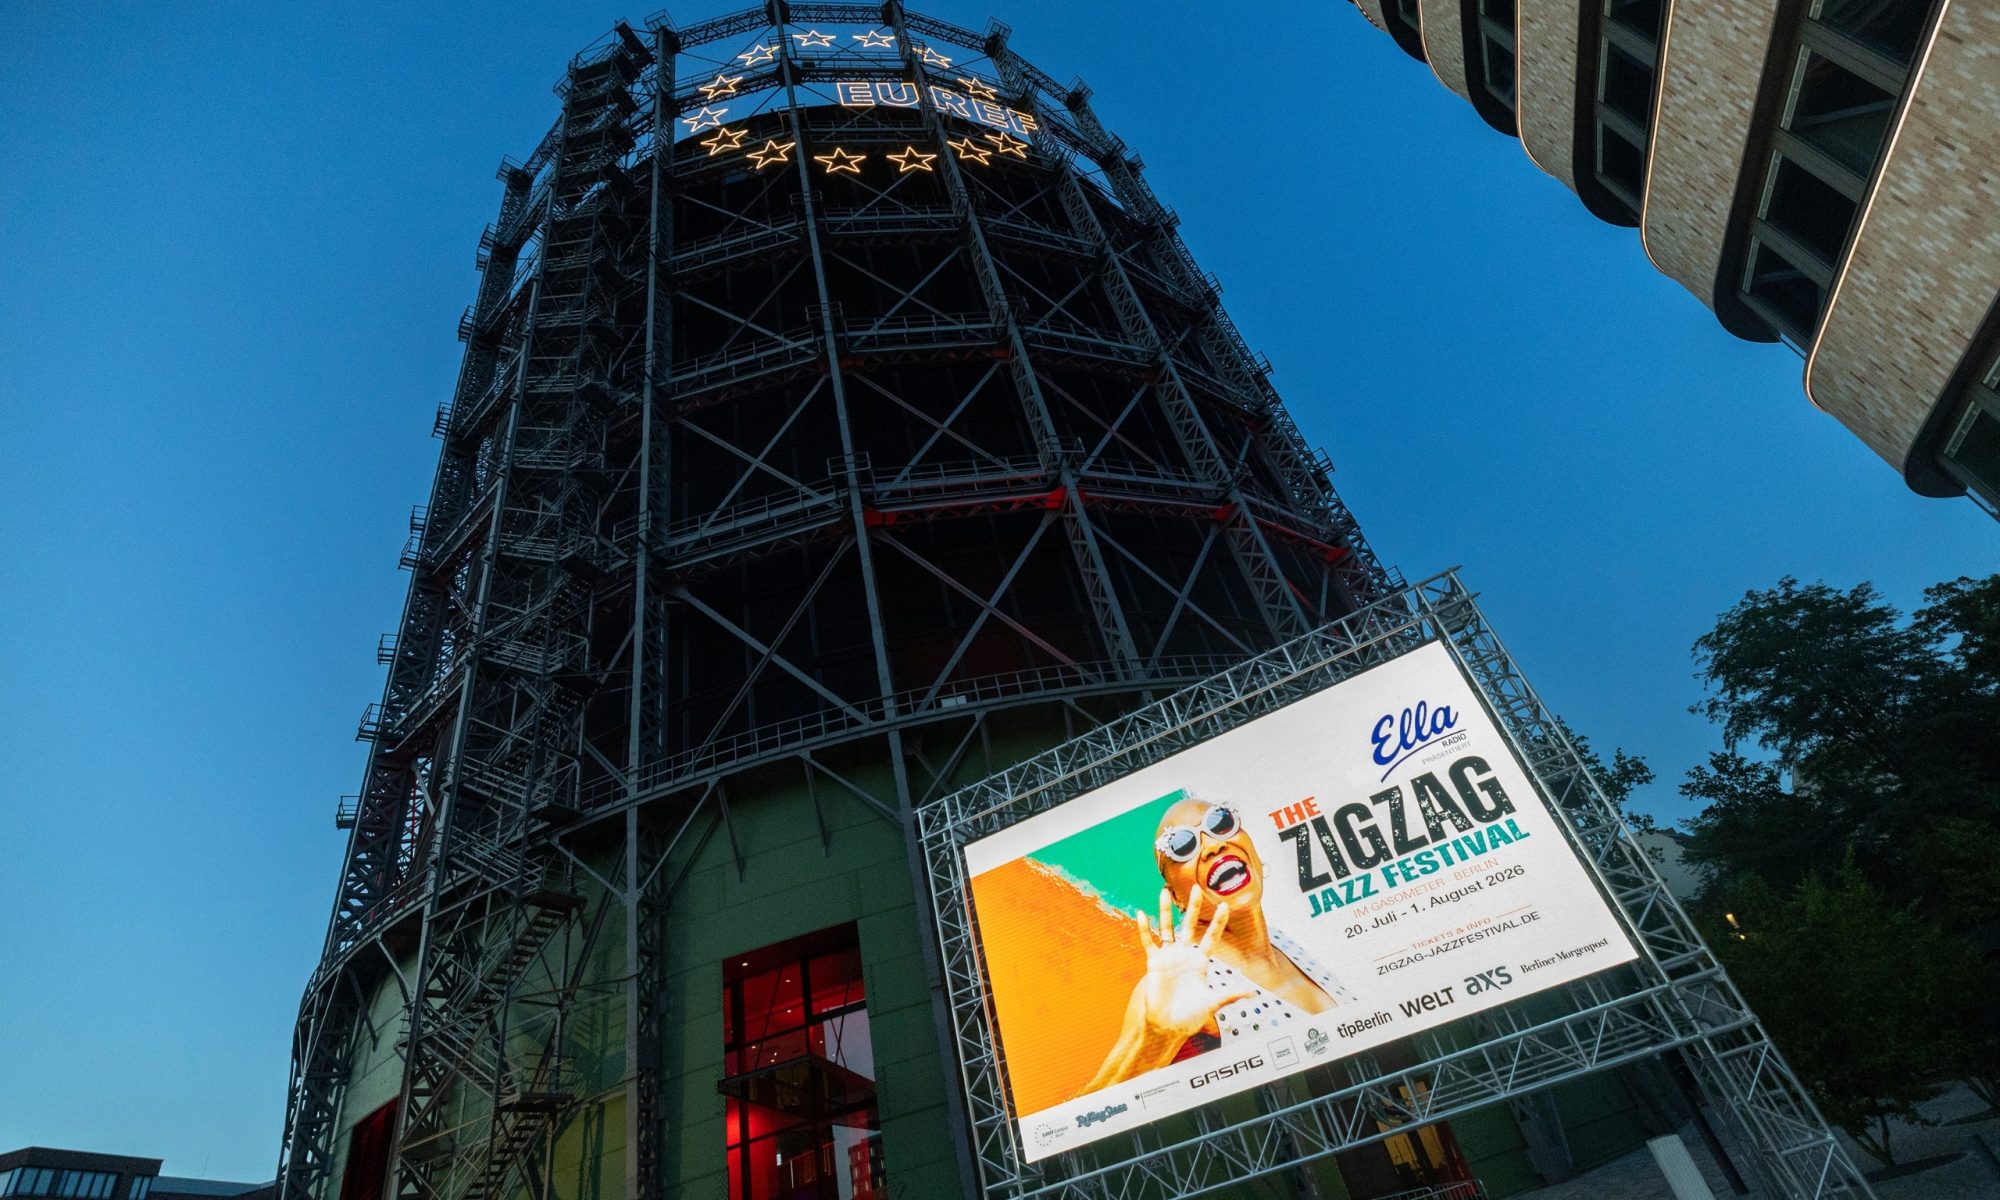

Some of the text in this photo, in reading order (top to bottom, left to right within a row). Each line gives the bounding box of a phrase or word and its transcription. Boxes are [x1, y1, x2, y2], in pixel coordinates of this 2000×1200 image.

[1371, 700, 1459, 766] Ella
[1441, 733, 1467, 748] RADIO
[1268, 796, 1320, 830] THE
[1279, 755, 1517, 894] ZIGZAG
[1307, 818, 1531, 919] JAZZ FESTIVAL
[1353, 857, 1500, 918] IM GASOMETER BERLIN
[1344, 923, 1368, 939] 20.
[1372, 910, 1397, 929] Juli
[1410, 903, 1426, 914] 1.
[1429, 880, 1484, 908] August
[1485, 864, 1525, 887] 2026
[1376, 910, 1541, 976] ZIGZAG-JAZZFESTIVAL.DE
[1411, 917, 1492, 950] TICKETS & INFO
[1520, 937, 1609, 974] Berliner Morgenpost
[1337, 1009, 1393, 1039] tipBerlin
[1189, 1054, 1265, 1090] GASAG
